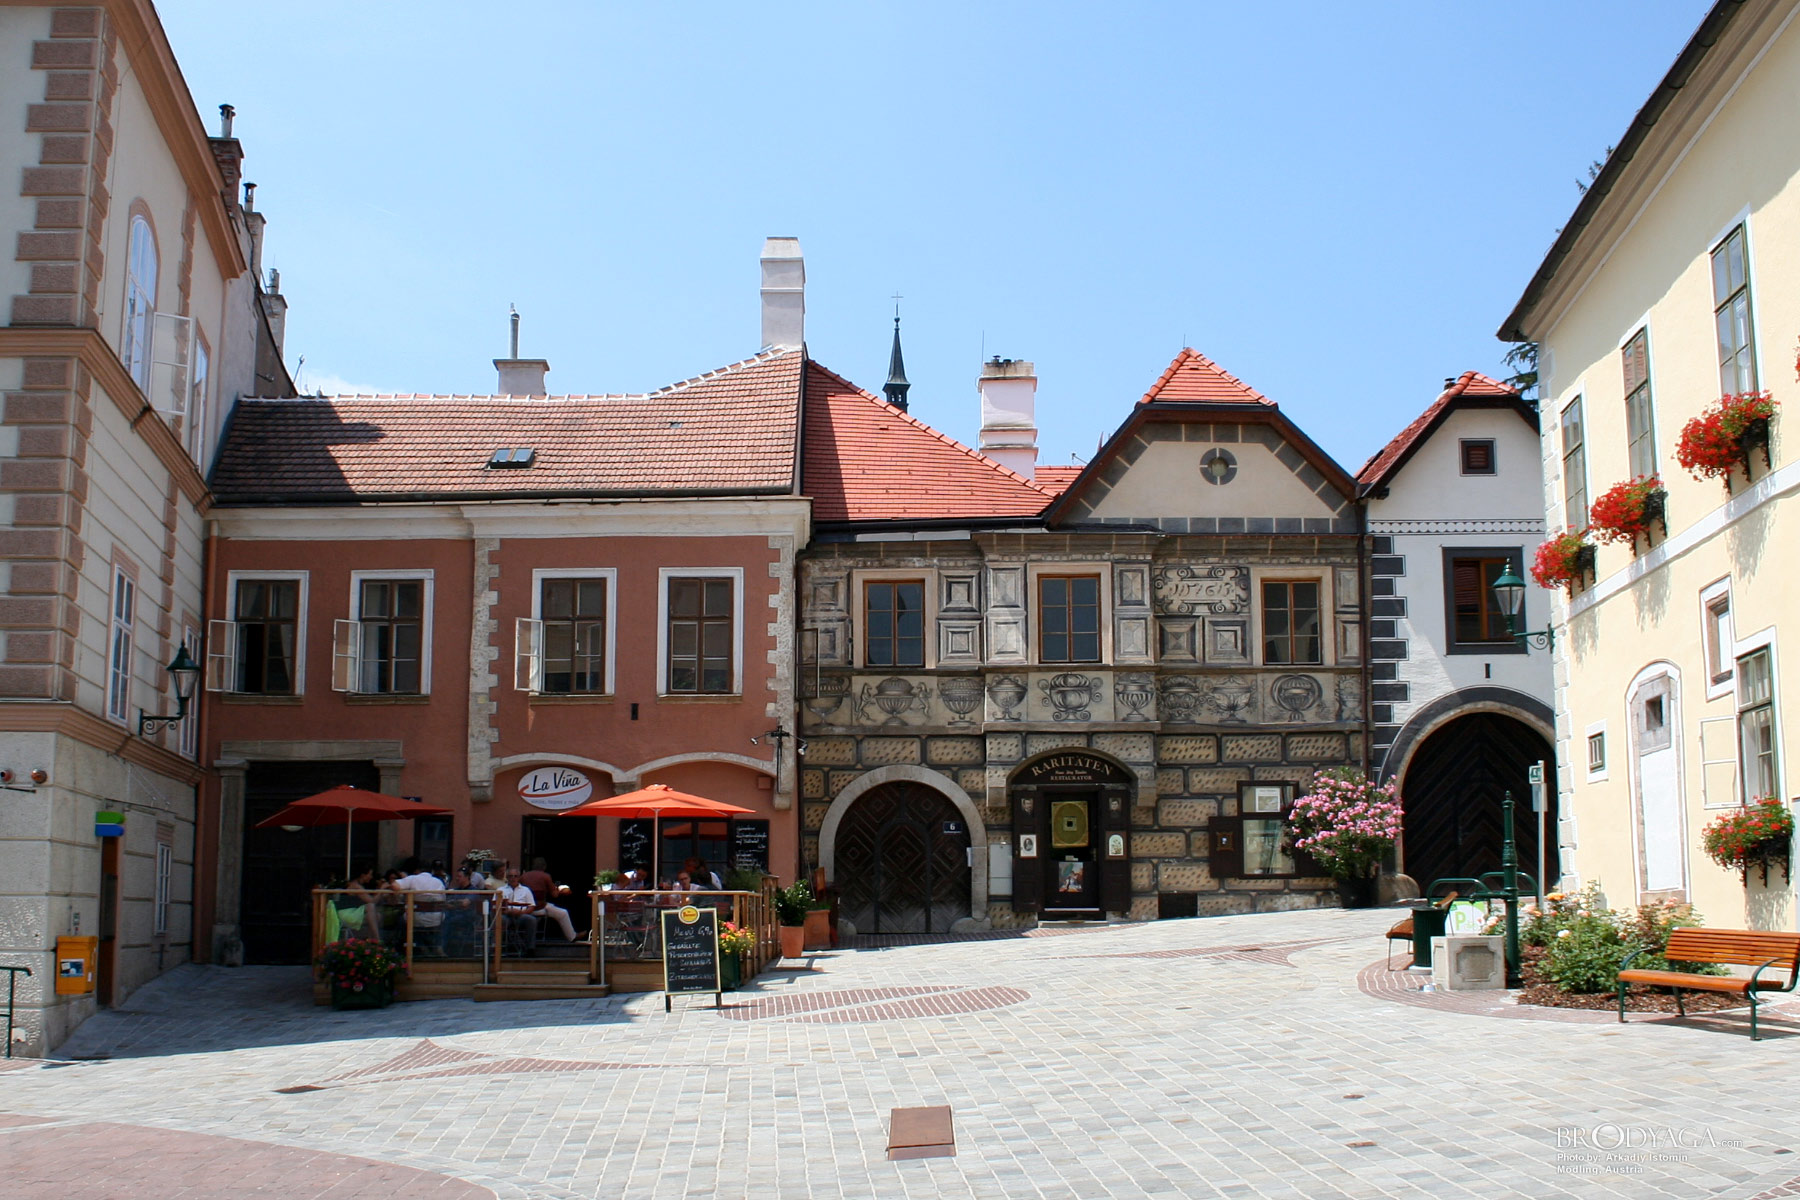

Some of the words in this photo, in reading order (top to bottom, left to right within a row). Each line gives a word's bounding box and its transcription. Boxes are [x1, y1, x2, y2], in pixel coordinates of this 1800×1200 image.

[532, 775, 549, 792] La
[554, 770, 580, 789] Viña
[1455, 911, 1466, 930] P
